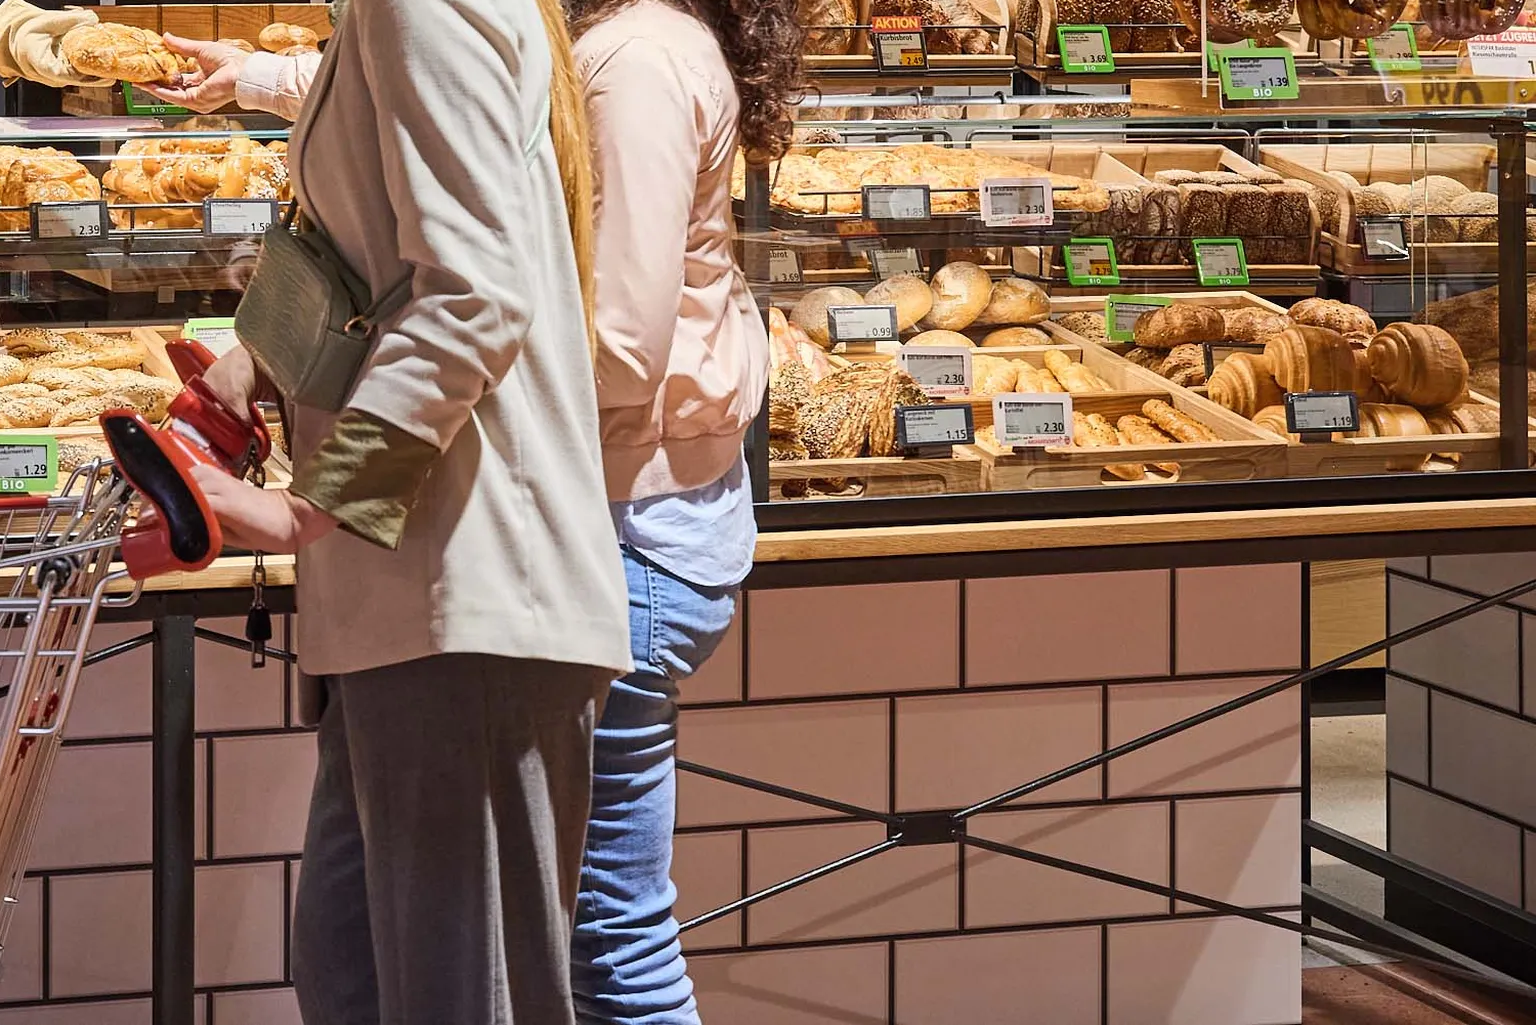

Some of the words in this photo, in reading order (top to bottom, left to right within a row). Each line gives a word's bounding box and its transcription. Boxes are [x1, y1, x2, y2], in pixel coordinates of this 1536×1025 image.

[875, 17, 918, 29] AKTION
[1089, 54, 1107, 63] 3.69
[1268, 77, 1289, 87] 1.39
[1252, 88, 1273, 97] BIO
[1025, 204, 1045, 214] 2.30
[79, 225, 100, 235] 2.39
[782, 272, 800, 281] 3.69
[871, 327, 891, 337] 0.99
[944, 373, 964, 384] 2.30
[1332, 416, 1352, 426] 1.19
[1044, 422, 1064, 433] 2.30
[946, 429, 966, 440] 1.15
[24, 464, 47, 475] 1.29
[2, 479, 25, 490] BIO
